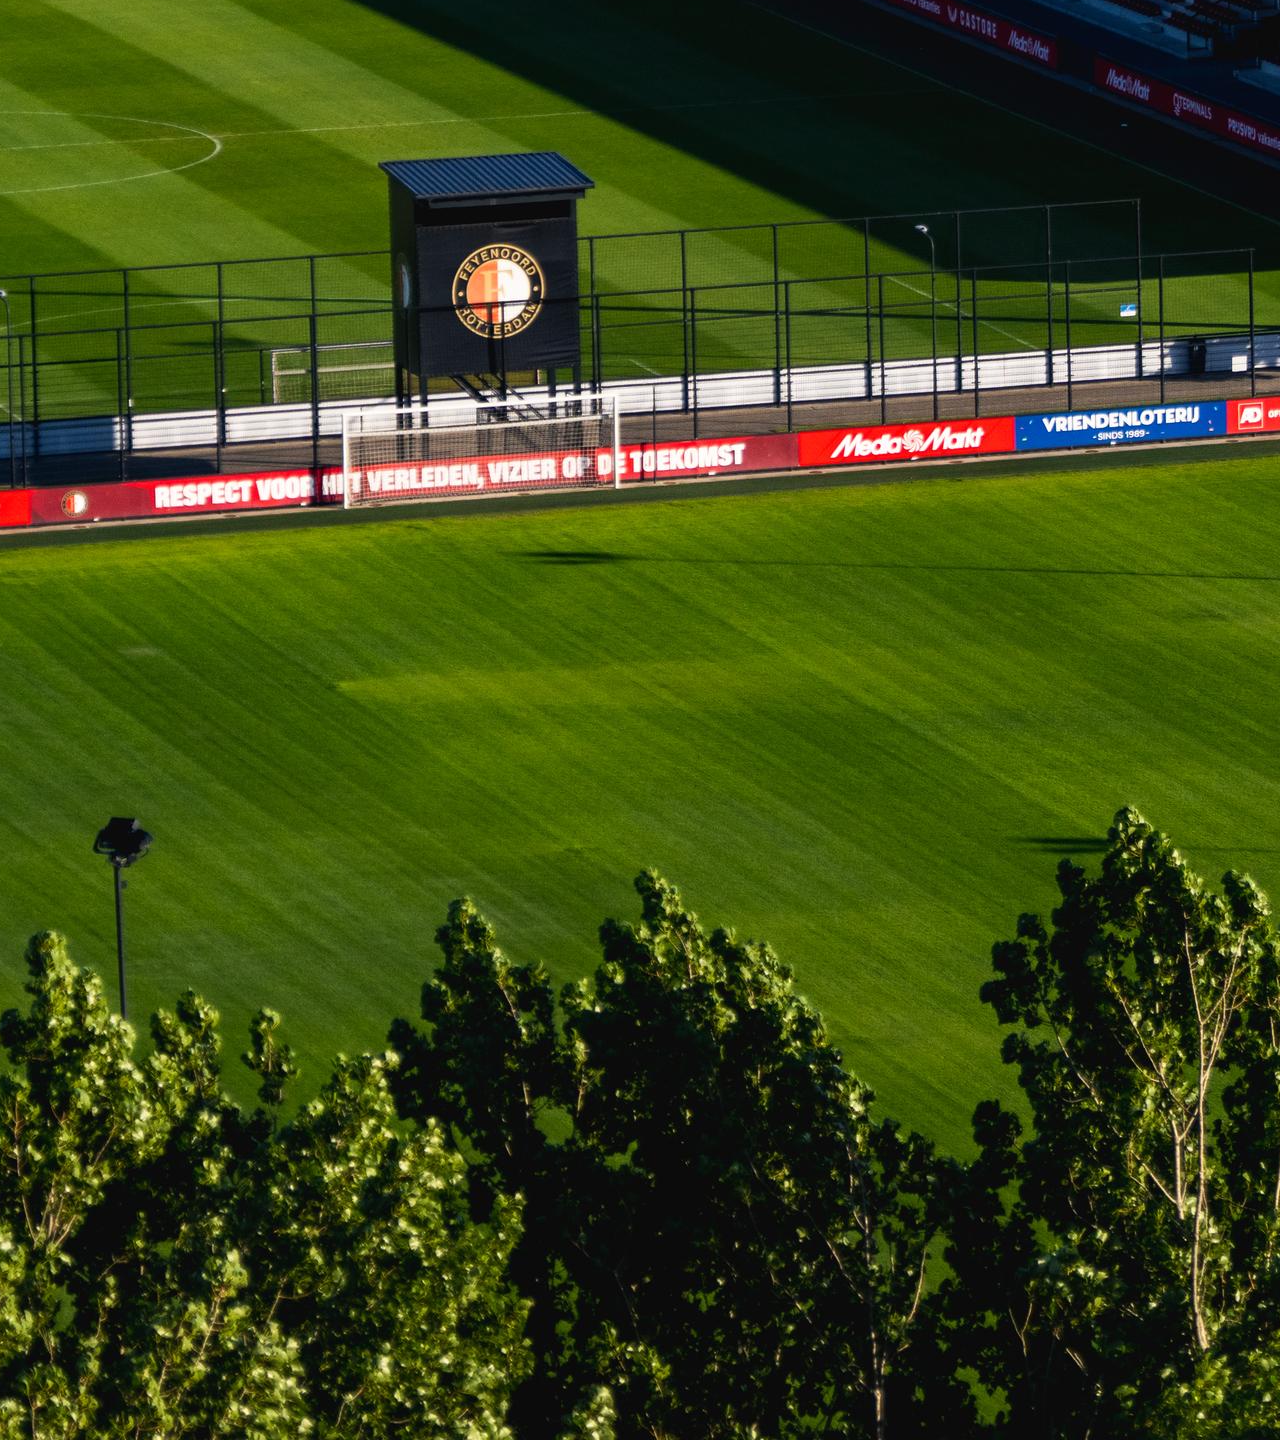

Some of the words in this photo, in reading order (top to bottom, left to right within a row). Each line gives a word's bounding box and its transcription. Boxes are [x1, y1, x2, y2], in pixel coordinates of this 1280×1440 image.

[960, 10, 997, 39] CASTORE
[459, 248, 537, 281] FEYENOORD
[1042, 406, 1200, 433] VRIENDENLOTERIJ
[1240, 407, 1262, 424] AD
[154, 481, 253, 509] RESPECT
[256, 475, 315, 501] VOOR
[488, 458, 556, 484] VIZIER
[562, 456, 591, 478] OP
[597, 452, 627, 475] DE
[630, 443, 746, 472] TOEKOMST
